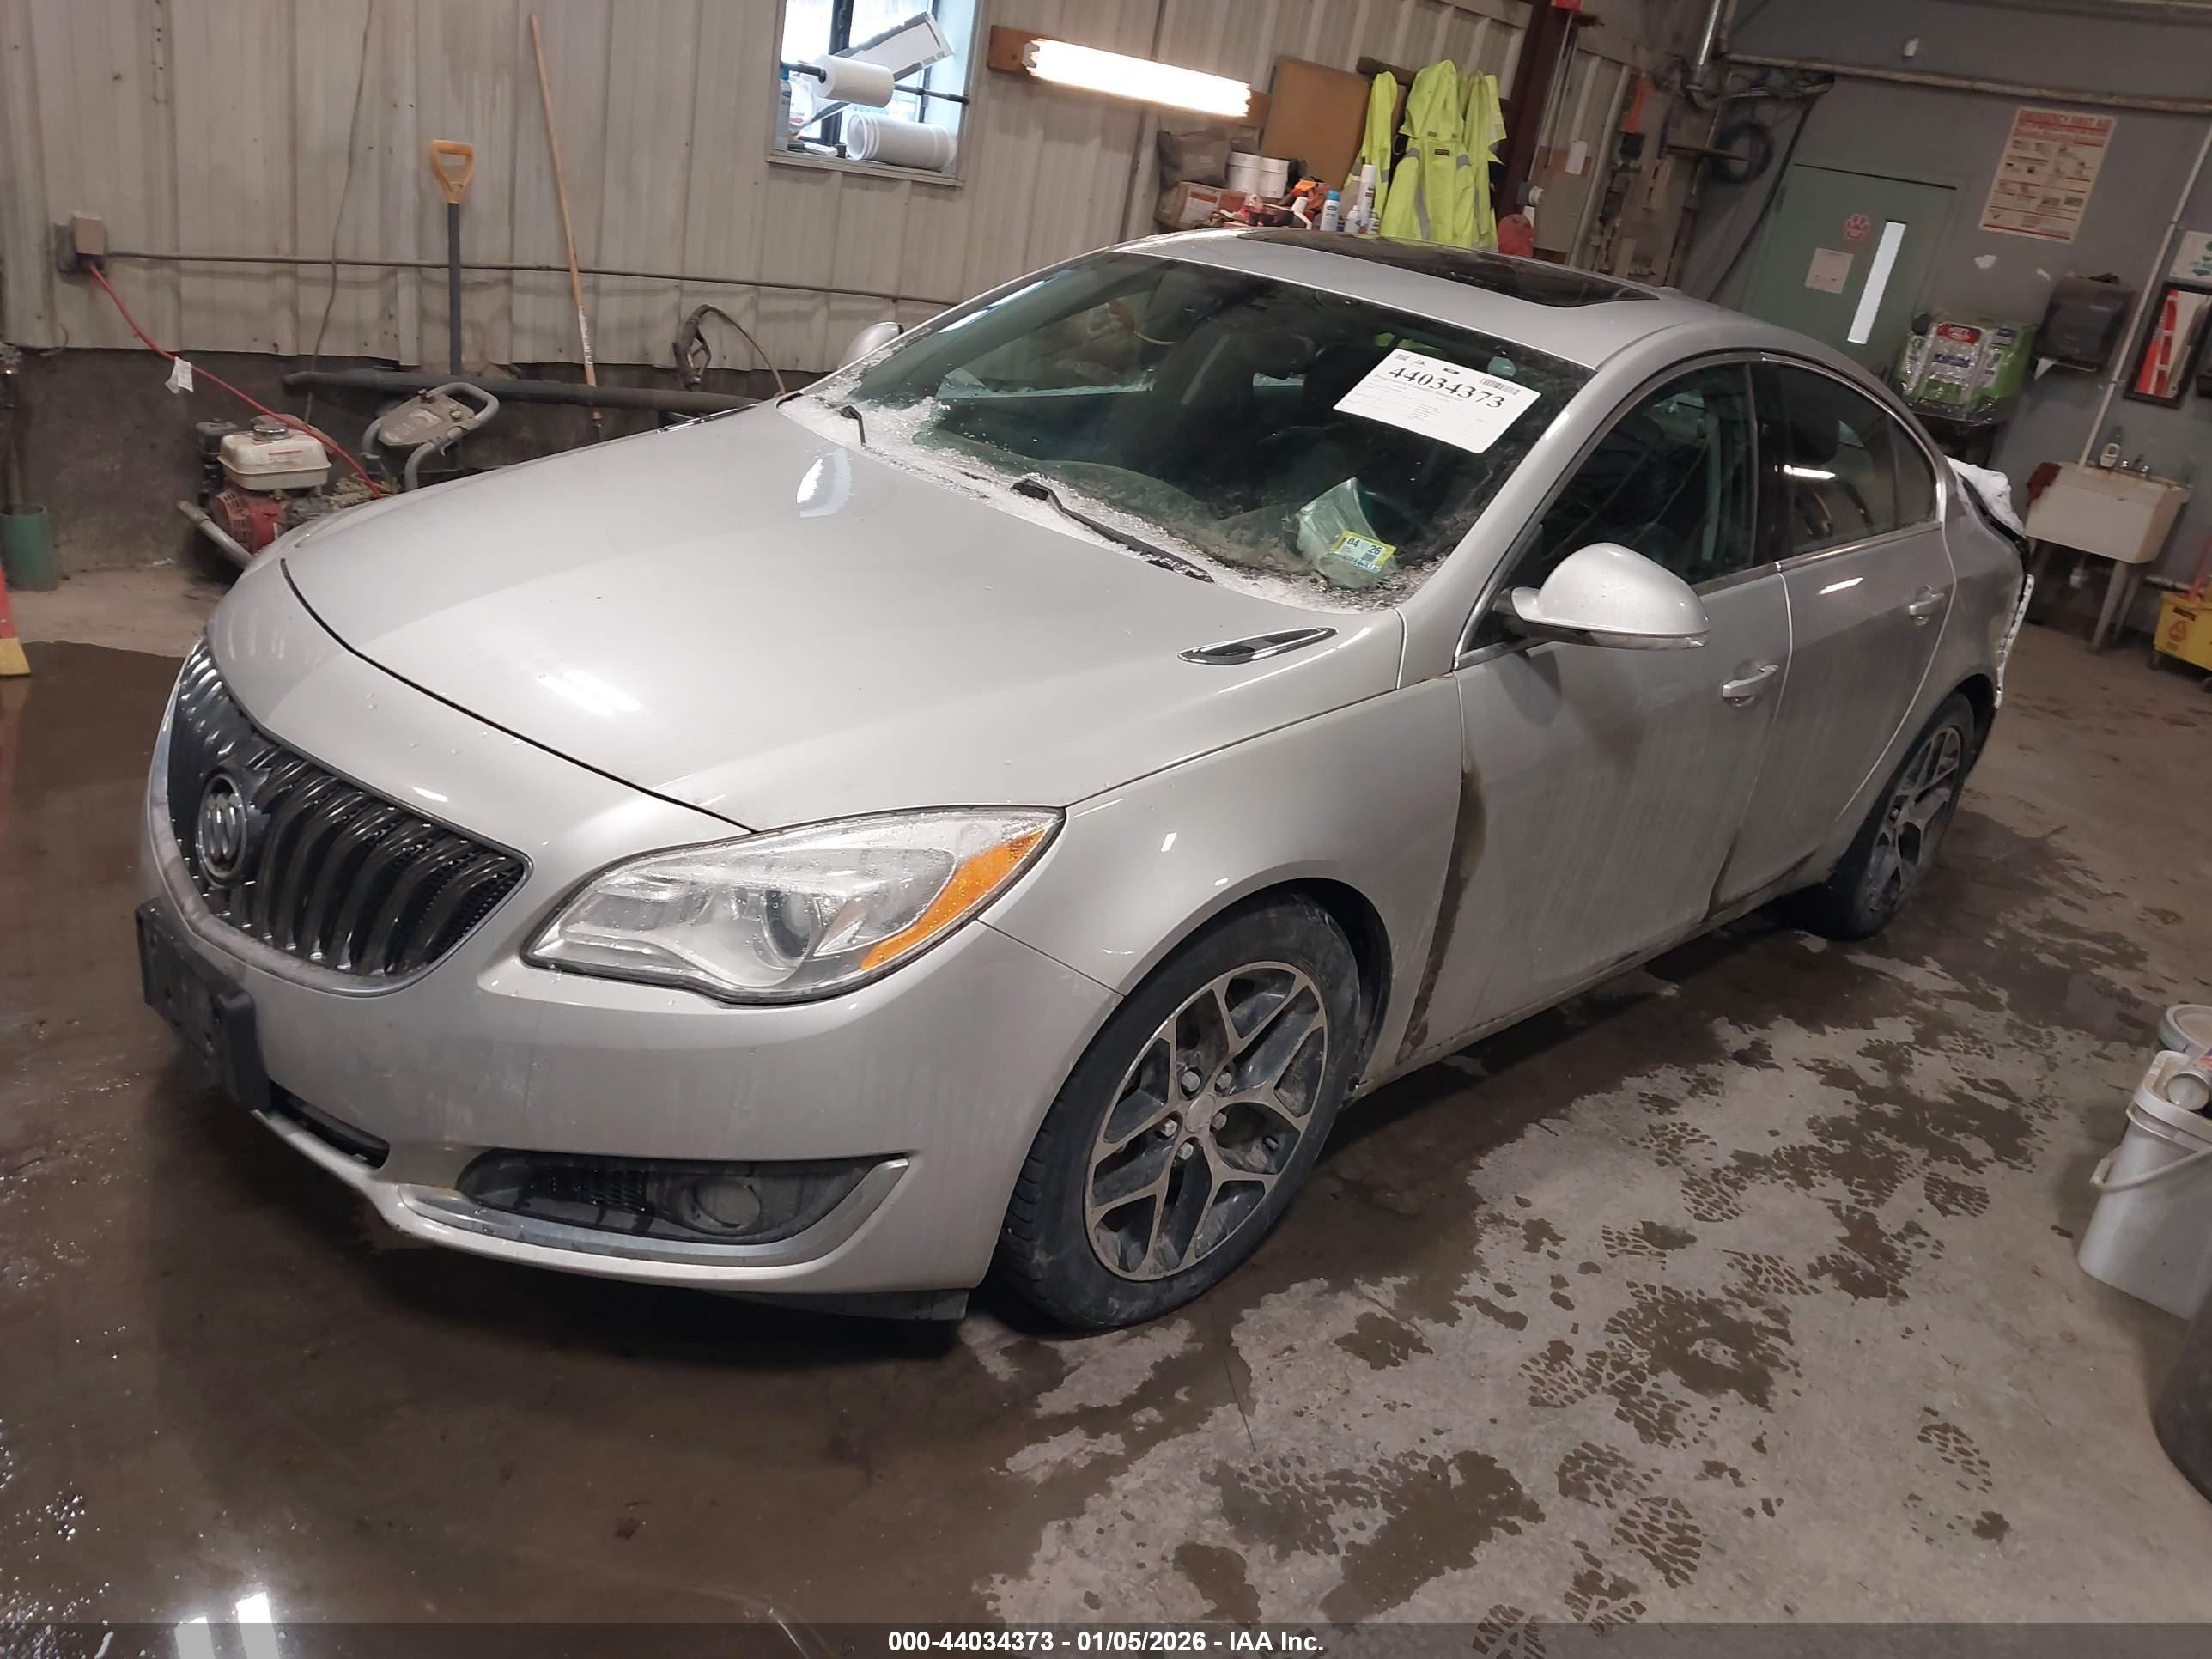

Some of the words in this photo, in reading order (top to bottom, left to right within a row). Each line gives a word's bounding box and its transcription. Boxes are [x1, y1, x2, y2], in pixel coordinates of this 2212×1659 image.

[1389, 367, 1506, 409] 44034373
[1346, 537, 1361, 548] 04
[1368, 544, 1382, 556] 26
